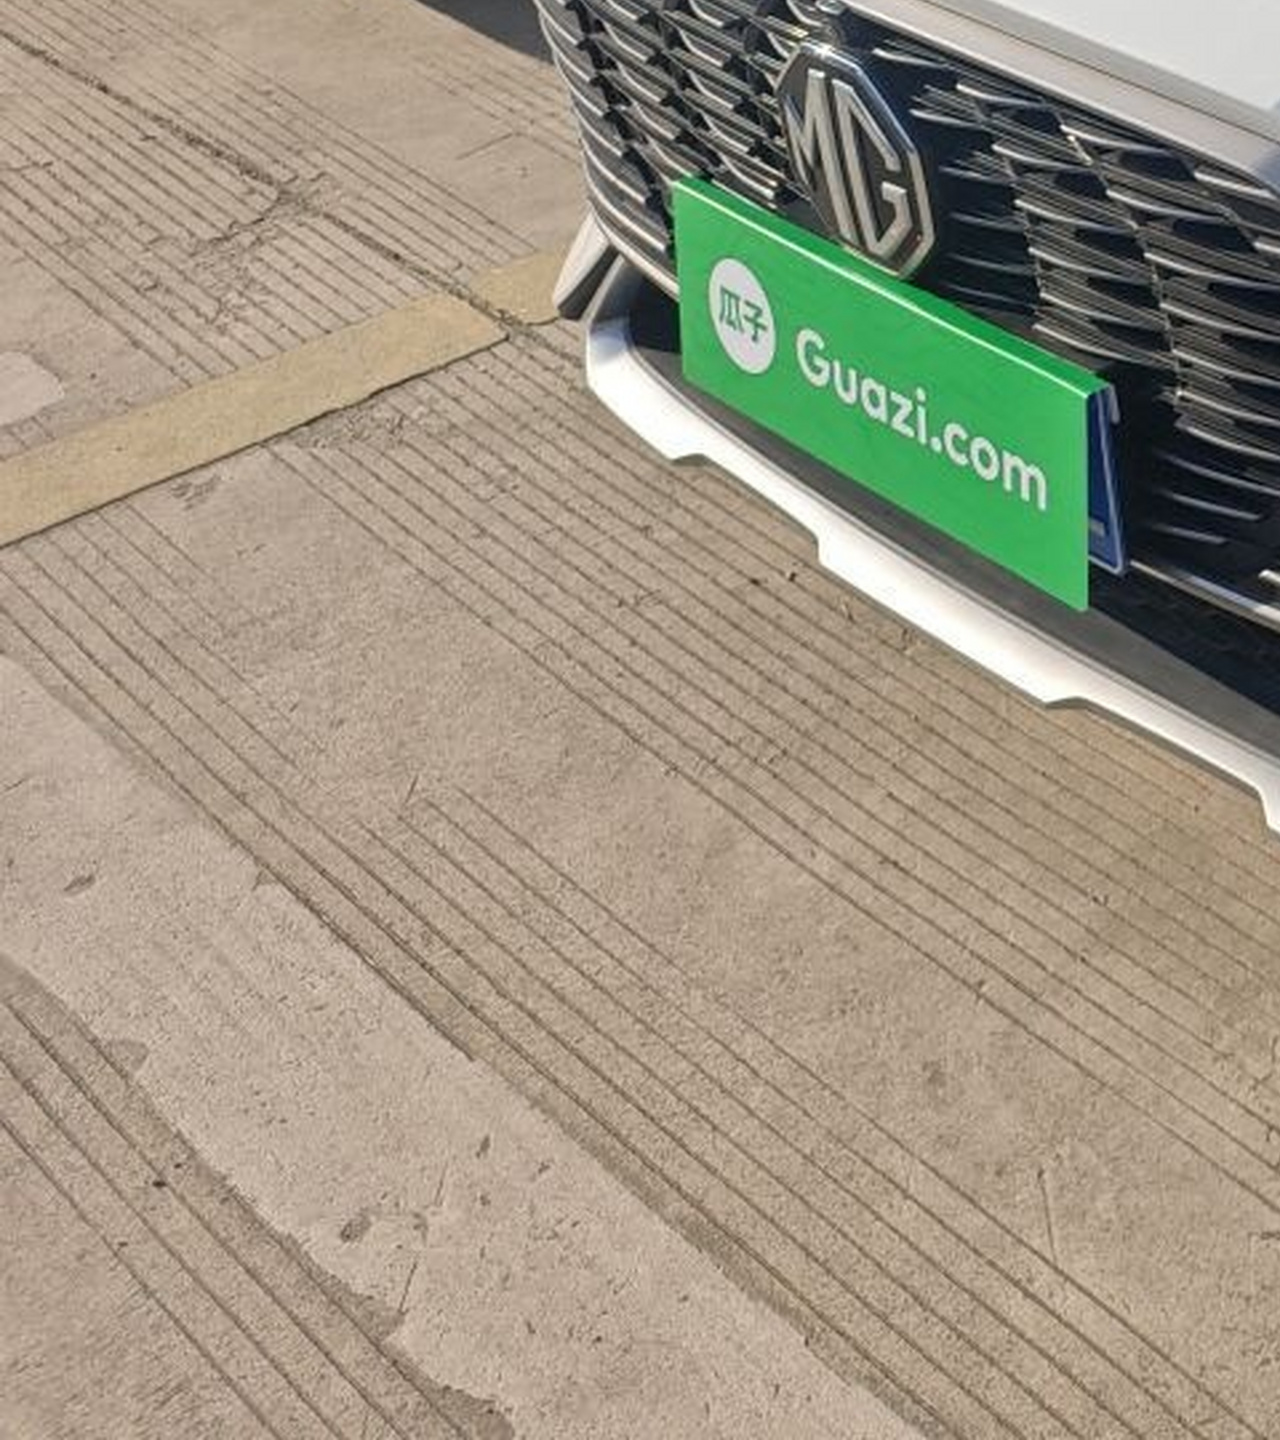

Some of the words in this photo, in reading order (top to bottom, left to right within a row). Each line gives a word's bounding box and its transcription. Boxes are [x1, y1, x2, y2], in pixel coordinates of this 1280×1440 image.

[785, 67, 913, 260] MG
[718, 286, 769, 343] 瓜子
[796, 328, 1047, 511] Guazi.com
